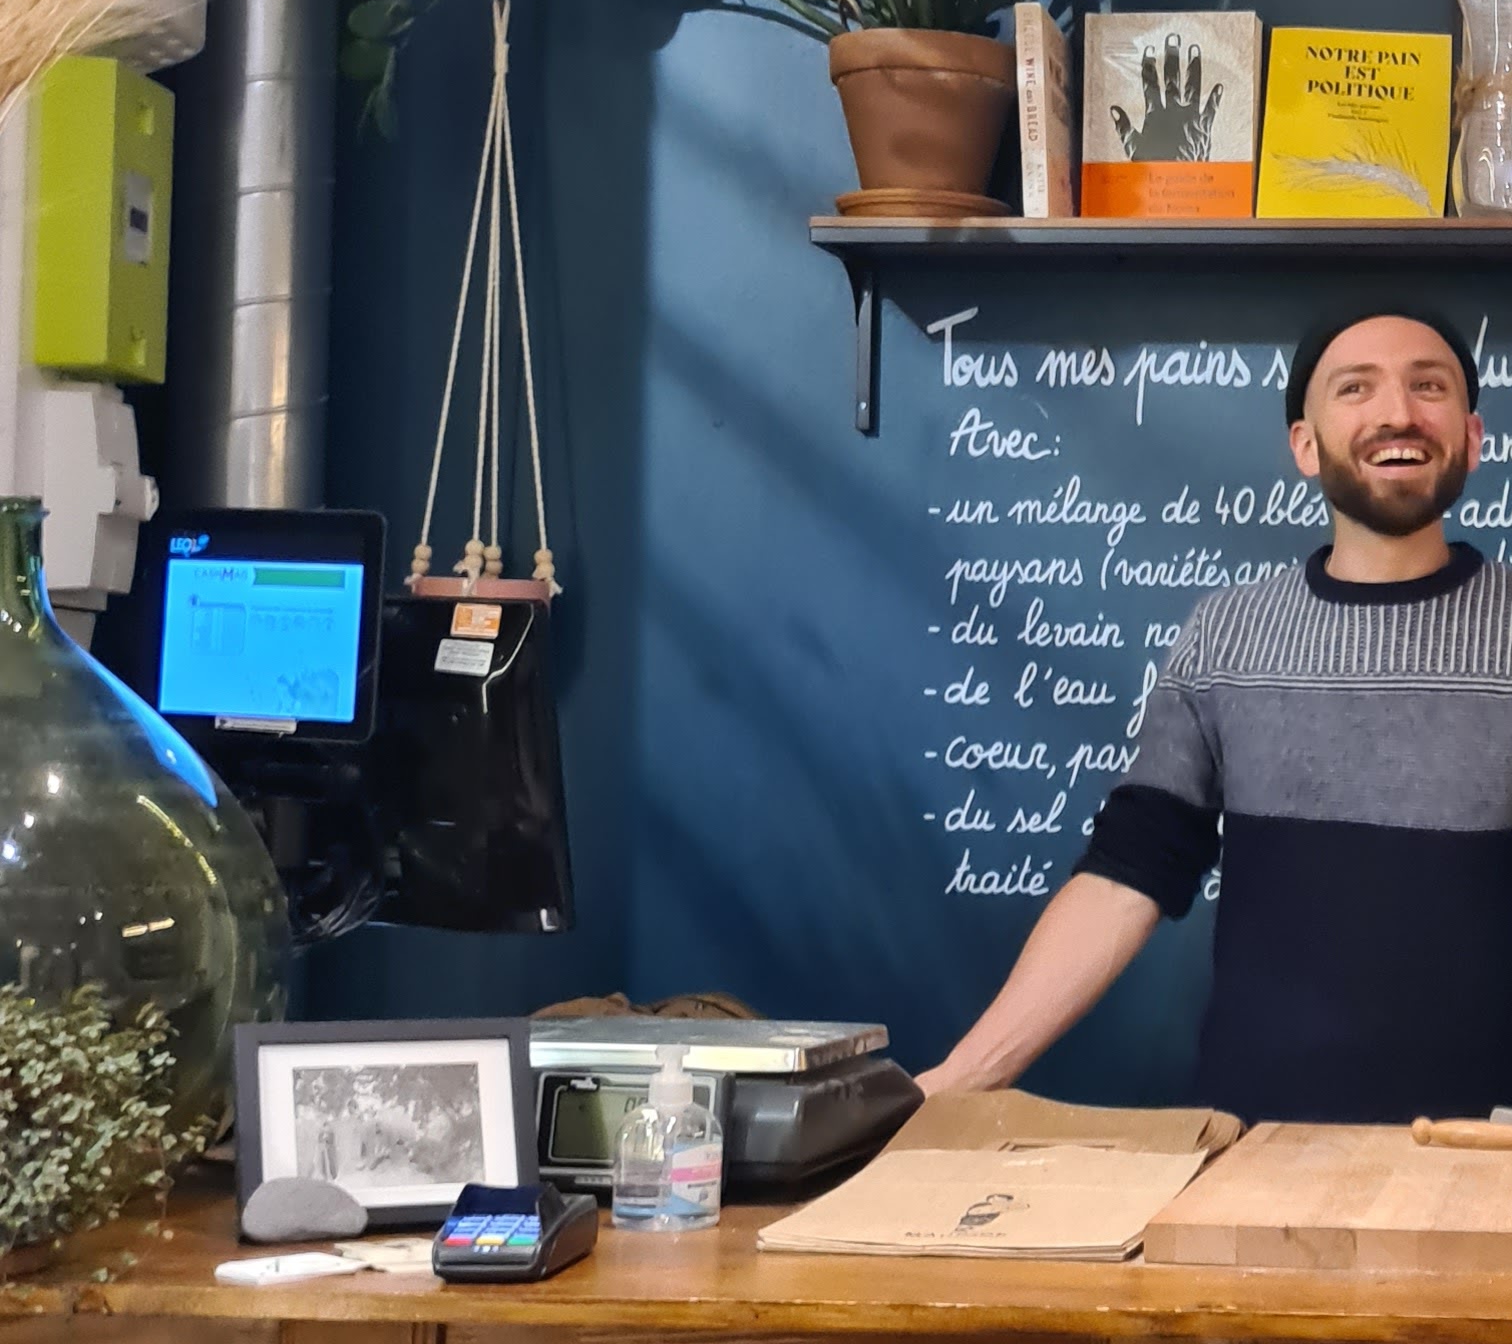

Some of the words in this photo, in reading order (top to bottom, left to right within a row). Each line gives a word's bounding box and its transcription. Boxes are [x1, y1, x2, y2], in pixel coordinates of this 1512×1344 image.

[1025, 57, 1037, 87] WINE
[1306, 46, 1374, 65] NOTRE
[1378, 51, 1422, 66] PAIN
[1345, 66, 1381, 81] EST
[1307, 79, 1415, 101] POLITIQUE
[1026, 106, 1038, 142] BREAD
[926, 306, 1018, 387] Tous
[1035, 347, 1116, 388] mes
[1123, 340, 1251, 426] pains
[1261, 346, 1289, 391] s
[1007, 475, 1147, 547] mélange
[1161, 484, 1200, 524] de
[1214, 485, 1256, 526] 40
[1259, 479, 1330, 527] blés
[945, 557, 1084, 607] paysans
[1017, 597, 1125, 648] levain
[1145, 625, 1181, 648] no
[1013, 661, 1117, 708] l'eau
[1126, 659, 1158, 739] f
[1065, 743, 1141, 789] pas
[1007, 790, 1067, 833] sel
[945, 848, 1054, 897] traité
